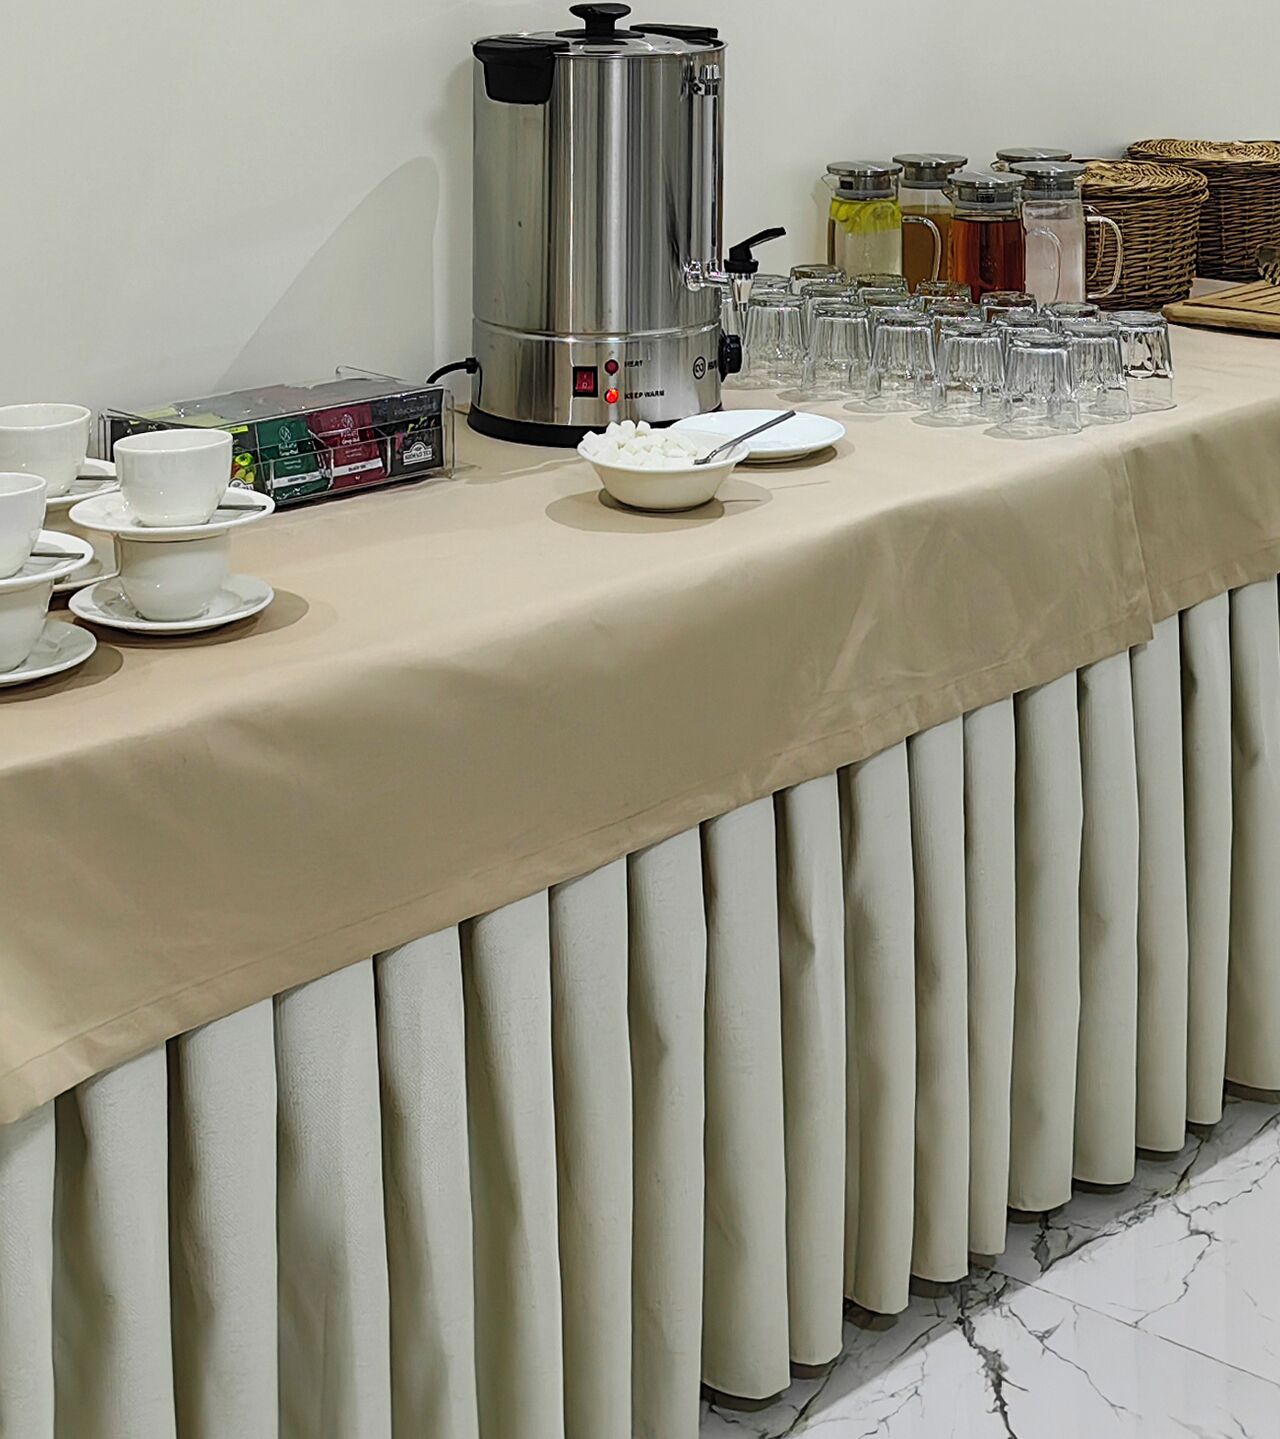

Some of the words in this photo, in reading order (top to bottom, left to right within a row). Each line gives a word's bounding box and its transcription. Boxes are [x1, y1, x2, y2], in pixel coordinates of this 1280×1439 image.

[624, 360, 643, 368] HEAT
[624, 392, 643, 400] KEEP
[644, 390, 665, 398] WARM
